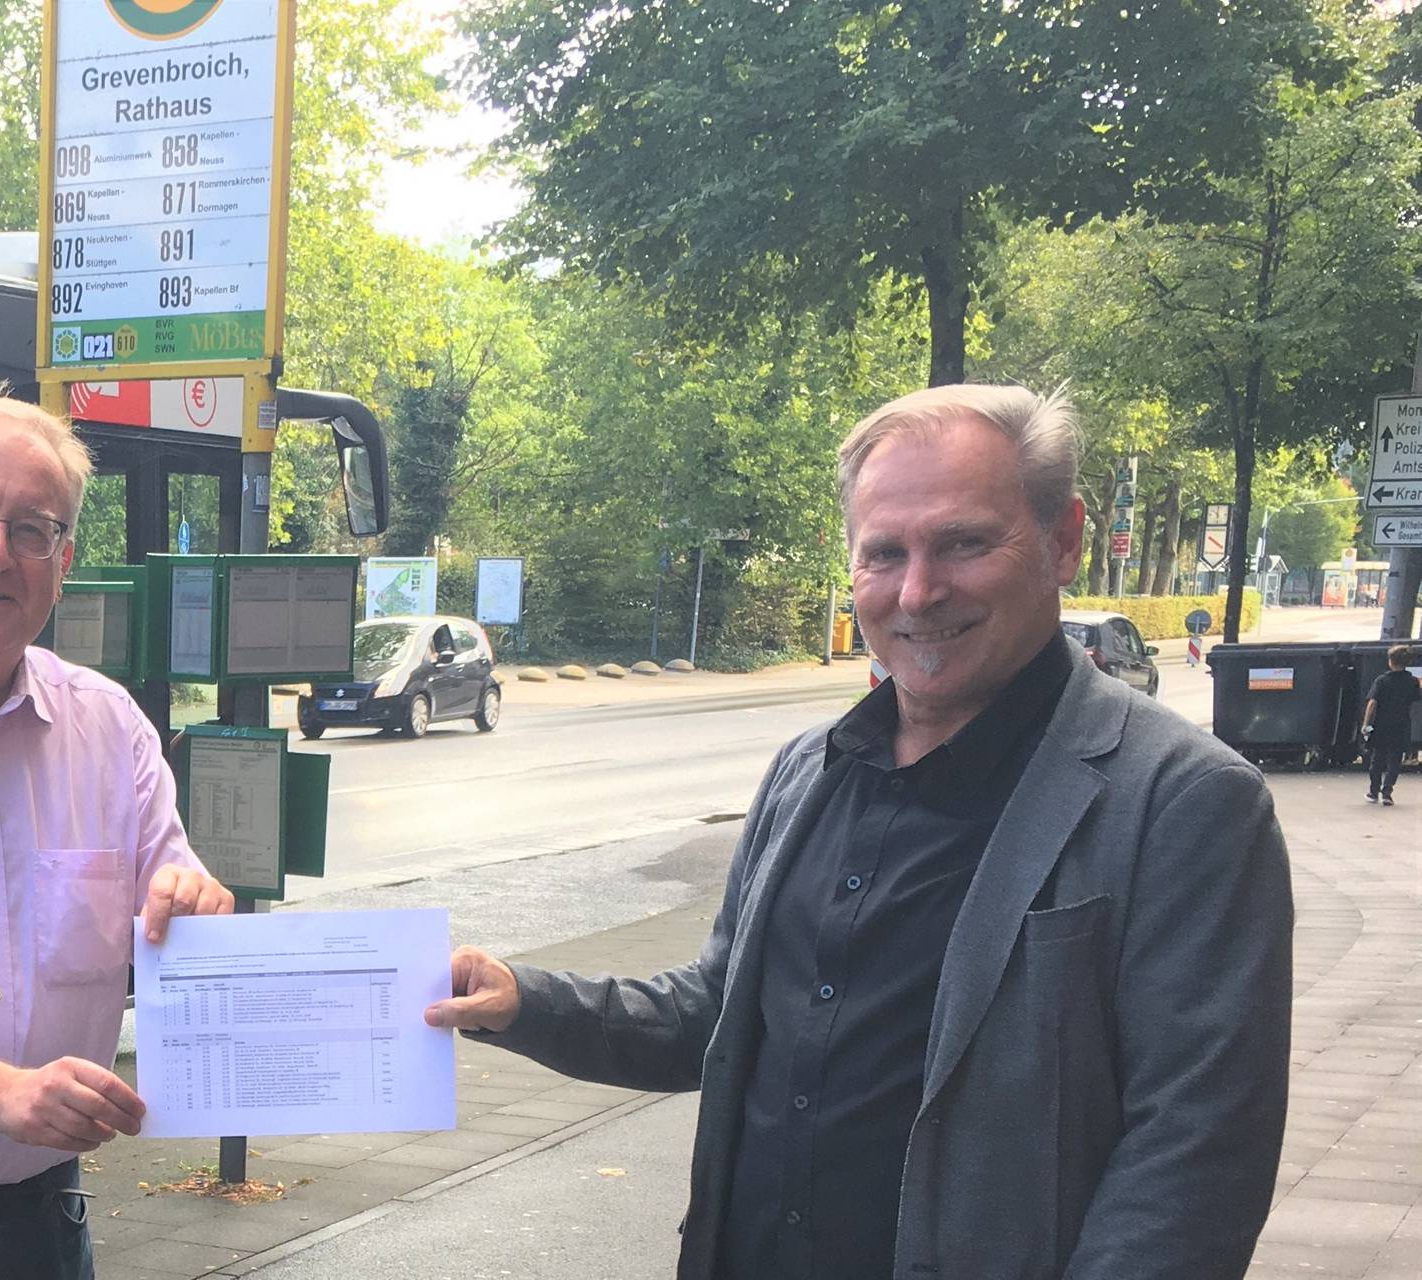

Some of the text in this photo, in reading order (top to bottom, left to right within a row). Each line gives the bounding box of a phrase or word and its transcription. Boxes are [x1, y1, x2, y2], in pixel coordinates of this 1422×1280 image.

[81, 52, 250, 91] Grevenbroich,
[115, 96, 212, 123] Rathaus
[200, 130, 235, 142] Kapellen
[94, 150, 152, 163] Aluminiumwerk
[162, 133, 198, 168] 858
[57, 144, 91, 178] 098
[199, 156, 224, 166] Neuss
[198, 176, 266, 189] Rommerskirchen
[88, 188, 120, 199] Kapellen
[163, 181, 196, 215] 871
[54, 190, 85, 224] 869
[198, 202, 238, 213] Dormagen
[88, 213, 110, 222] Neuss
[86, 234, 128, 245] Neukirchen
[160, 228, 194, 262] 891
[53, 237, 84, 269] 878
[86, 259, 117, 269] Stüttgen
[159, 275, 192, 309] 893
[194, 284, 240, 297] Kapellen Bf
[52, 282, 83, 315] 892
[155, 319, 175, 329] BVR
[155, 331, 175, 341] RVG
[188, 319, 264, 352] MöBus
[83, 334, 114, 359] 021
[117, 335, 136, 351] 610
[154, 343, 176, 353] SWN
